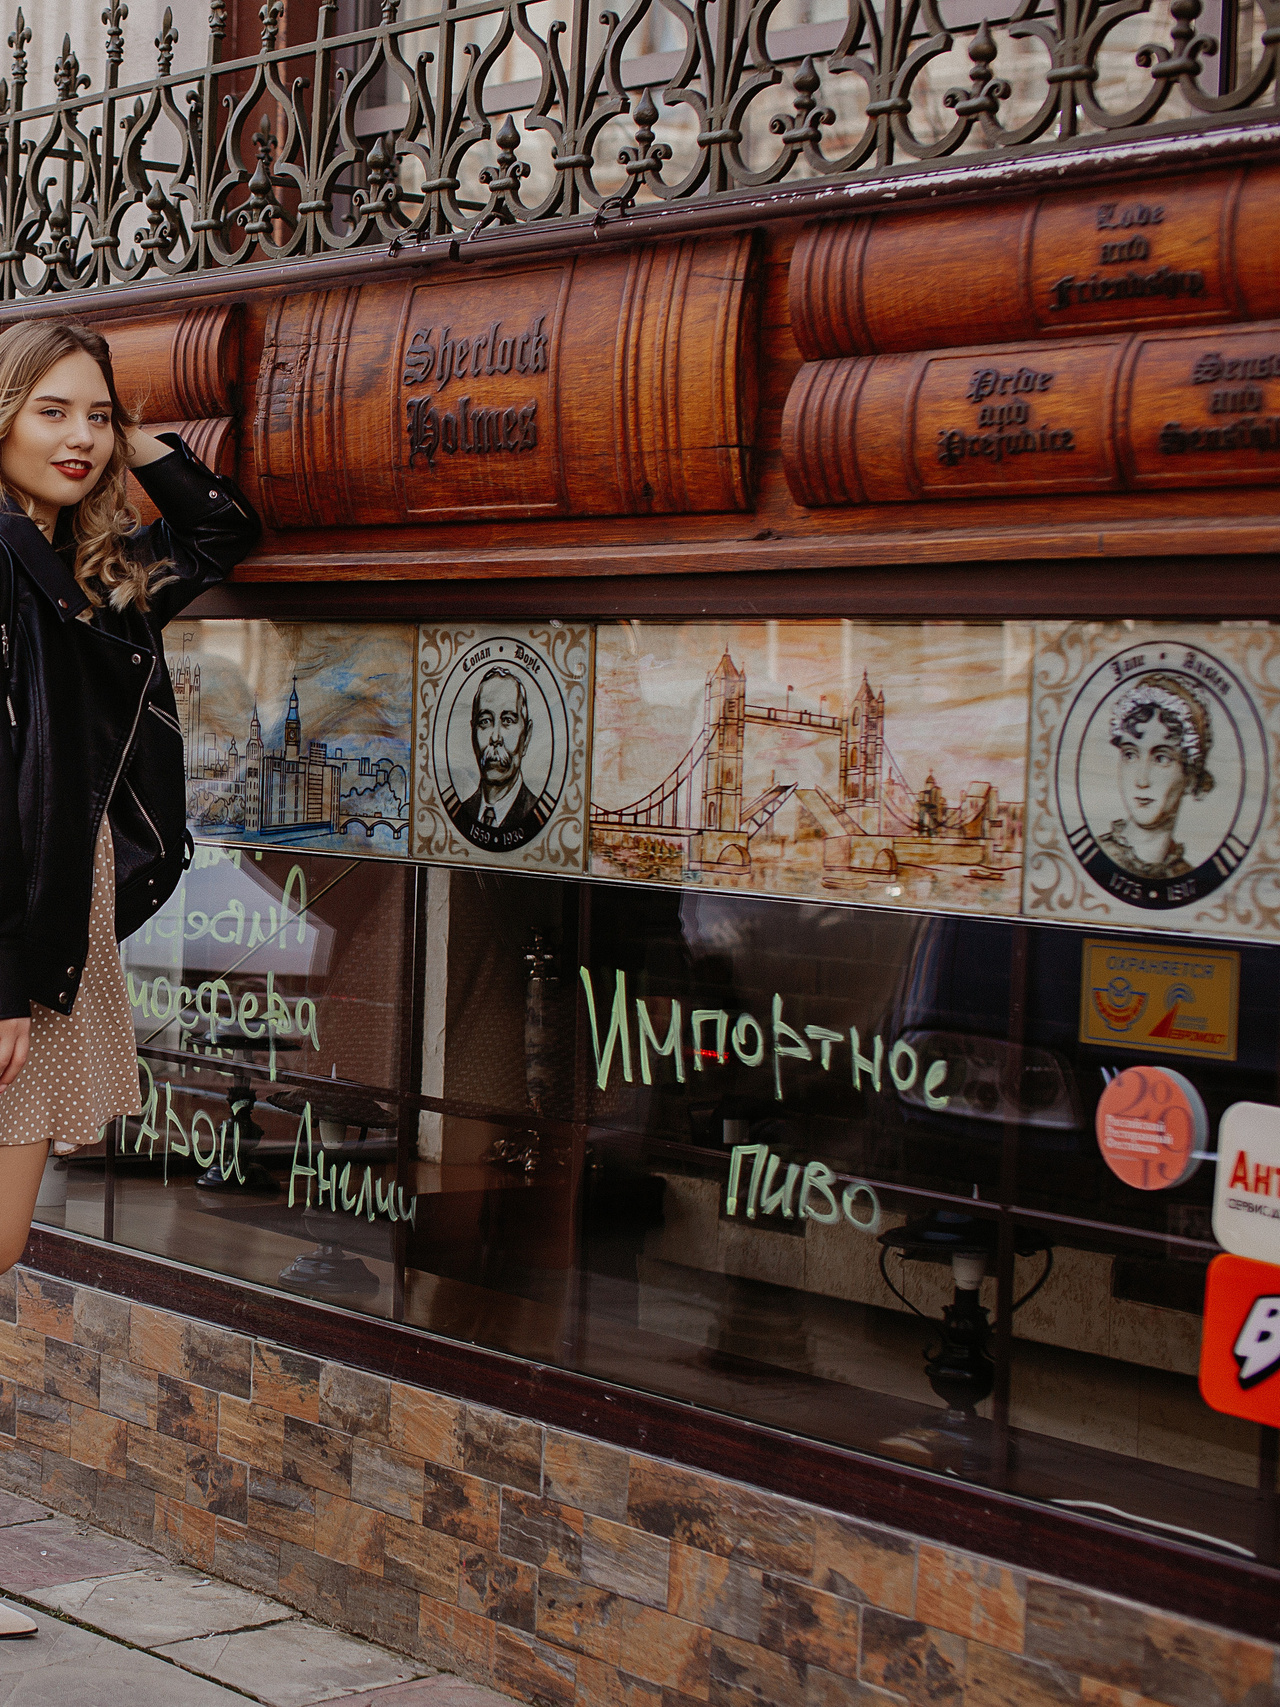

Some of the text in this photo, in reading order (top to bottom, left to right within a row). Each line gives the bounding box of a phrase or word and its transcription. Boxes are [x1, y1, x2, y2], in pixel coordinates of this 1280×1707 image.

[403, 315, 549, 392] Sherlock
[966, 367, 1055, 404] Pride
[406, 394, 538, 468] Holmes
[462, 643, 541, 675] Conan Doyle
[470, 824, 491, 844] 1859
